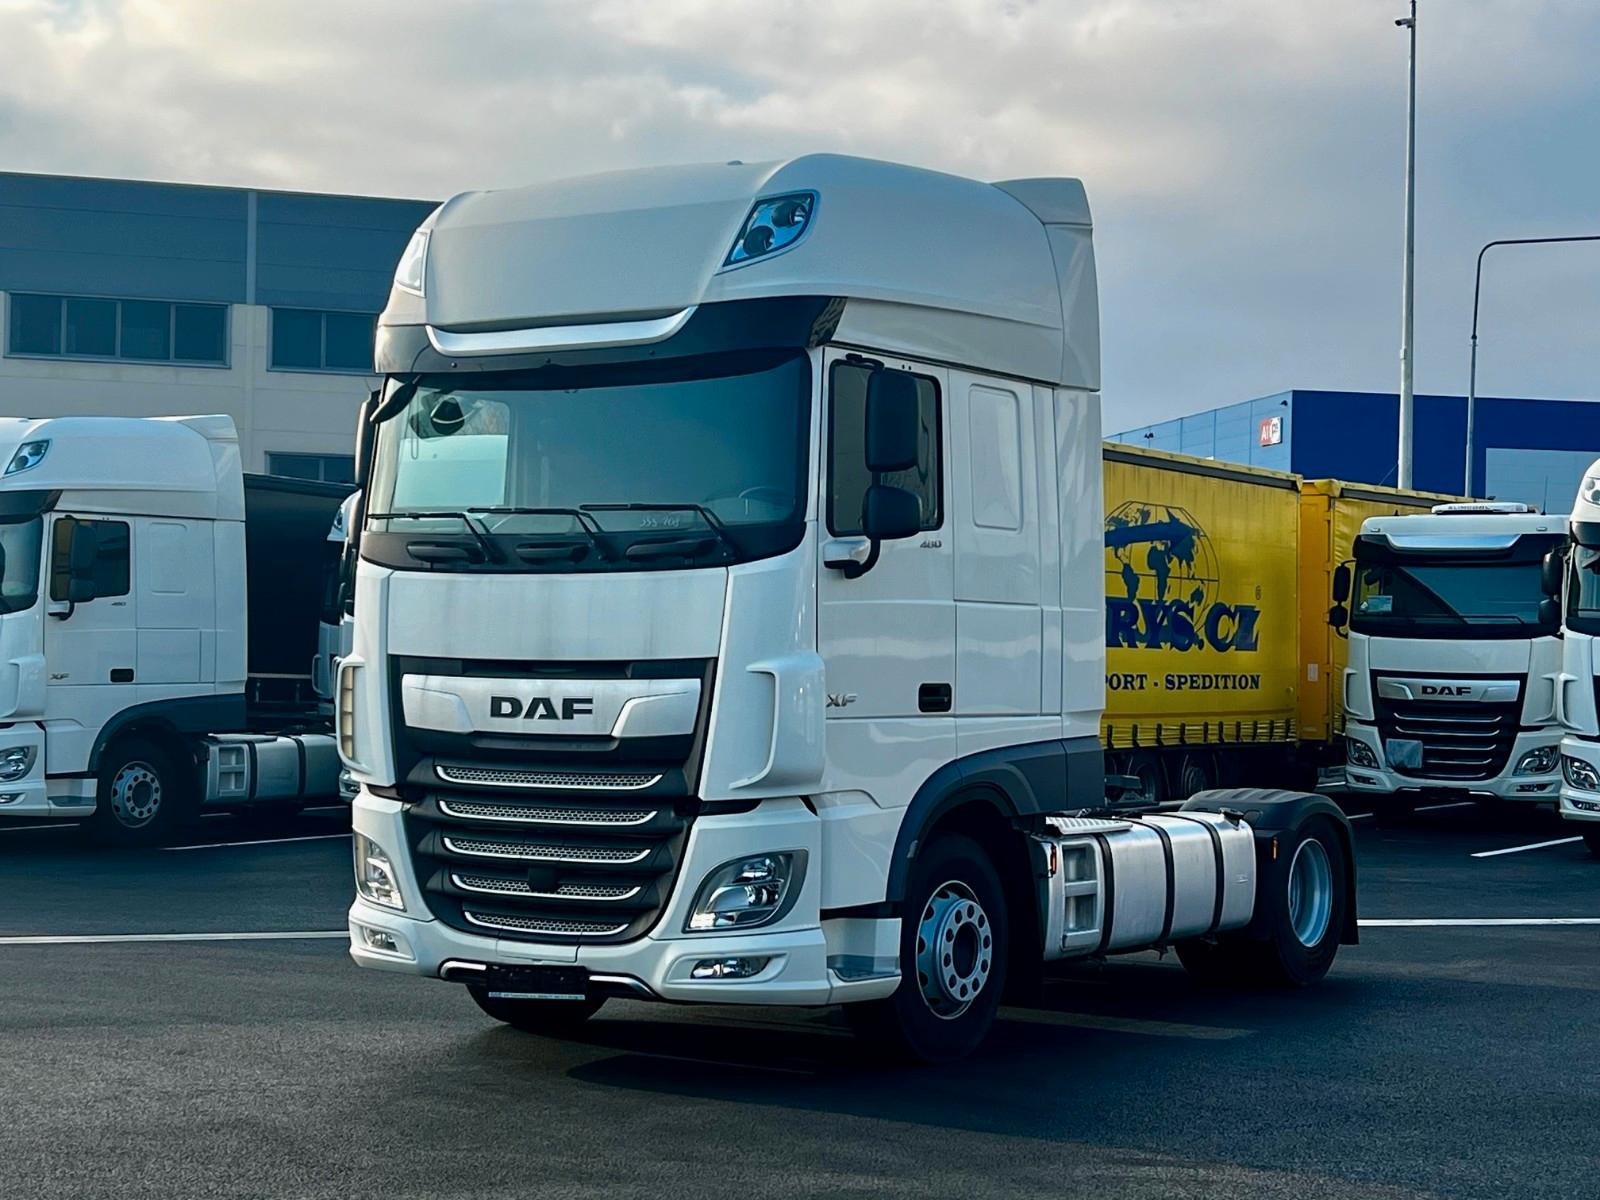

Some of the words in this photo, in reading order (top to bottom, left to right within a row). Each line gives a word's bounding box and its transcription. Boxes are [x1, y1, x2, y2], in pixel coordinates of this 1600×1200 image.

[1106, 674, 1148, 690] ORT
[1165, 673, 1261, 691] SPEDITION
[1421, 685, 1472, 696] DAF
[490, 696, 594, 720] DAF
[826, 693, 858, 708] XF
